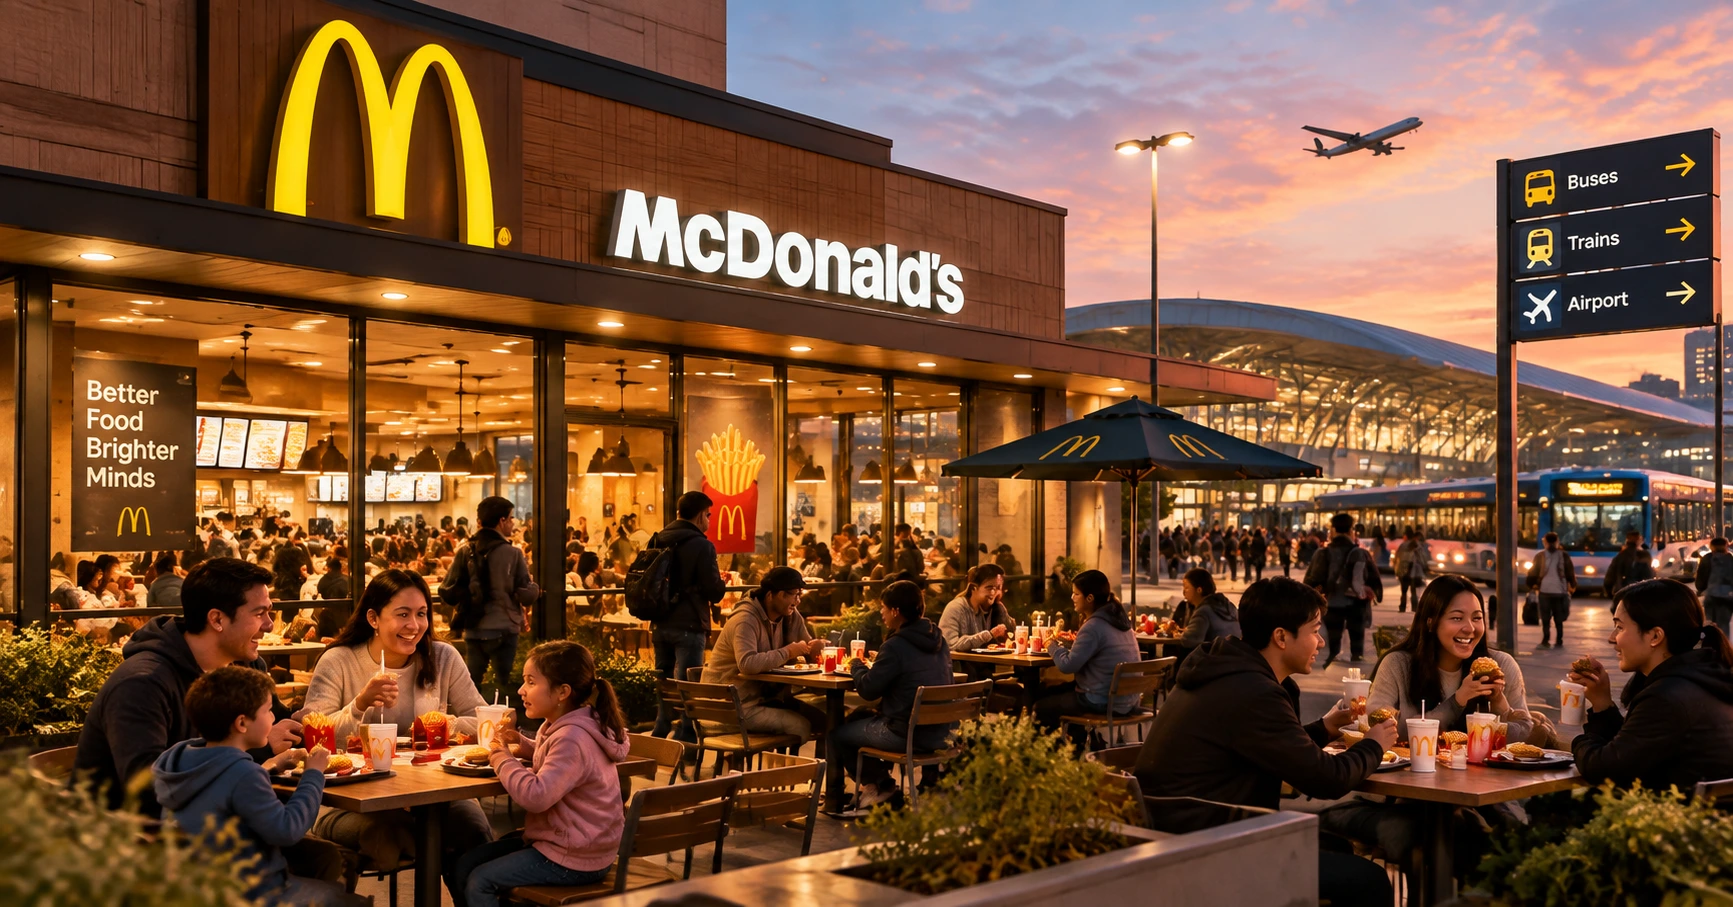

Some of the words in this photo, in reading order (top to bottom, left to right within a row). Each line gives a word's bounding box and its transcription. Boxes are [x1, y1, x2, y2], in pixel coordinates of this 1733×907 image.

[1567, 170, 1619, 190] Buses
[611, 188, 965, 315] McDonald's
[1567, 232, 1620, 251] Trains
[1567, 291, 1629, 313] Airport
[86, 379, 160, 406] Better
[86, 408, 144, 432] Food
[86, 436, 179, 465] Brighter
[86, 466, 156, 488] Minds
